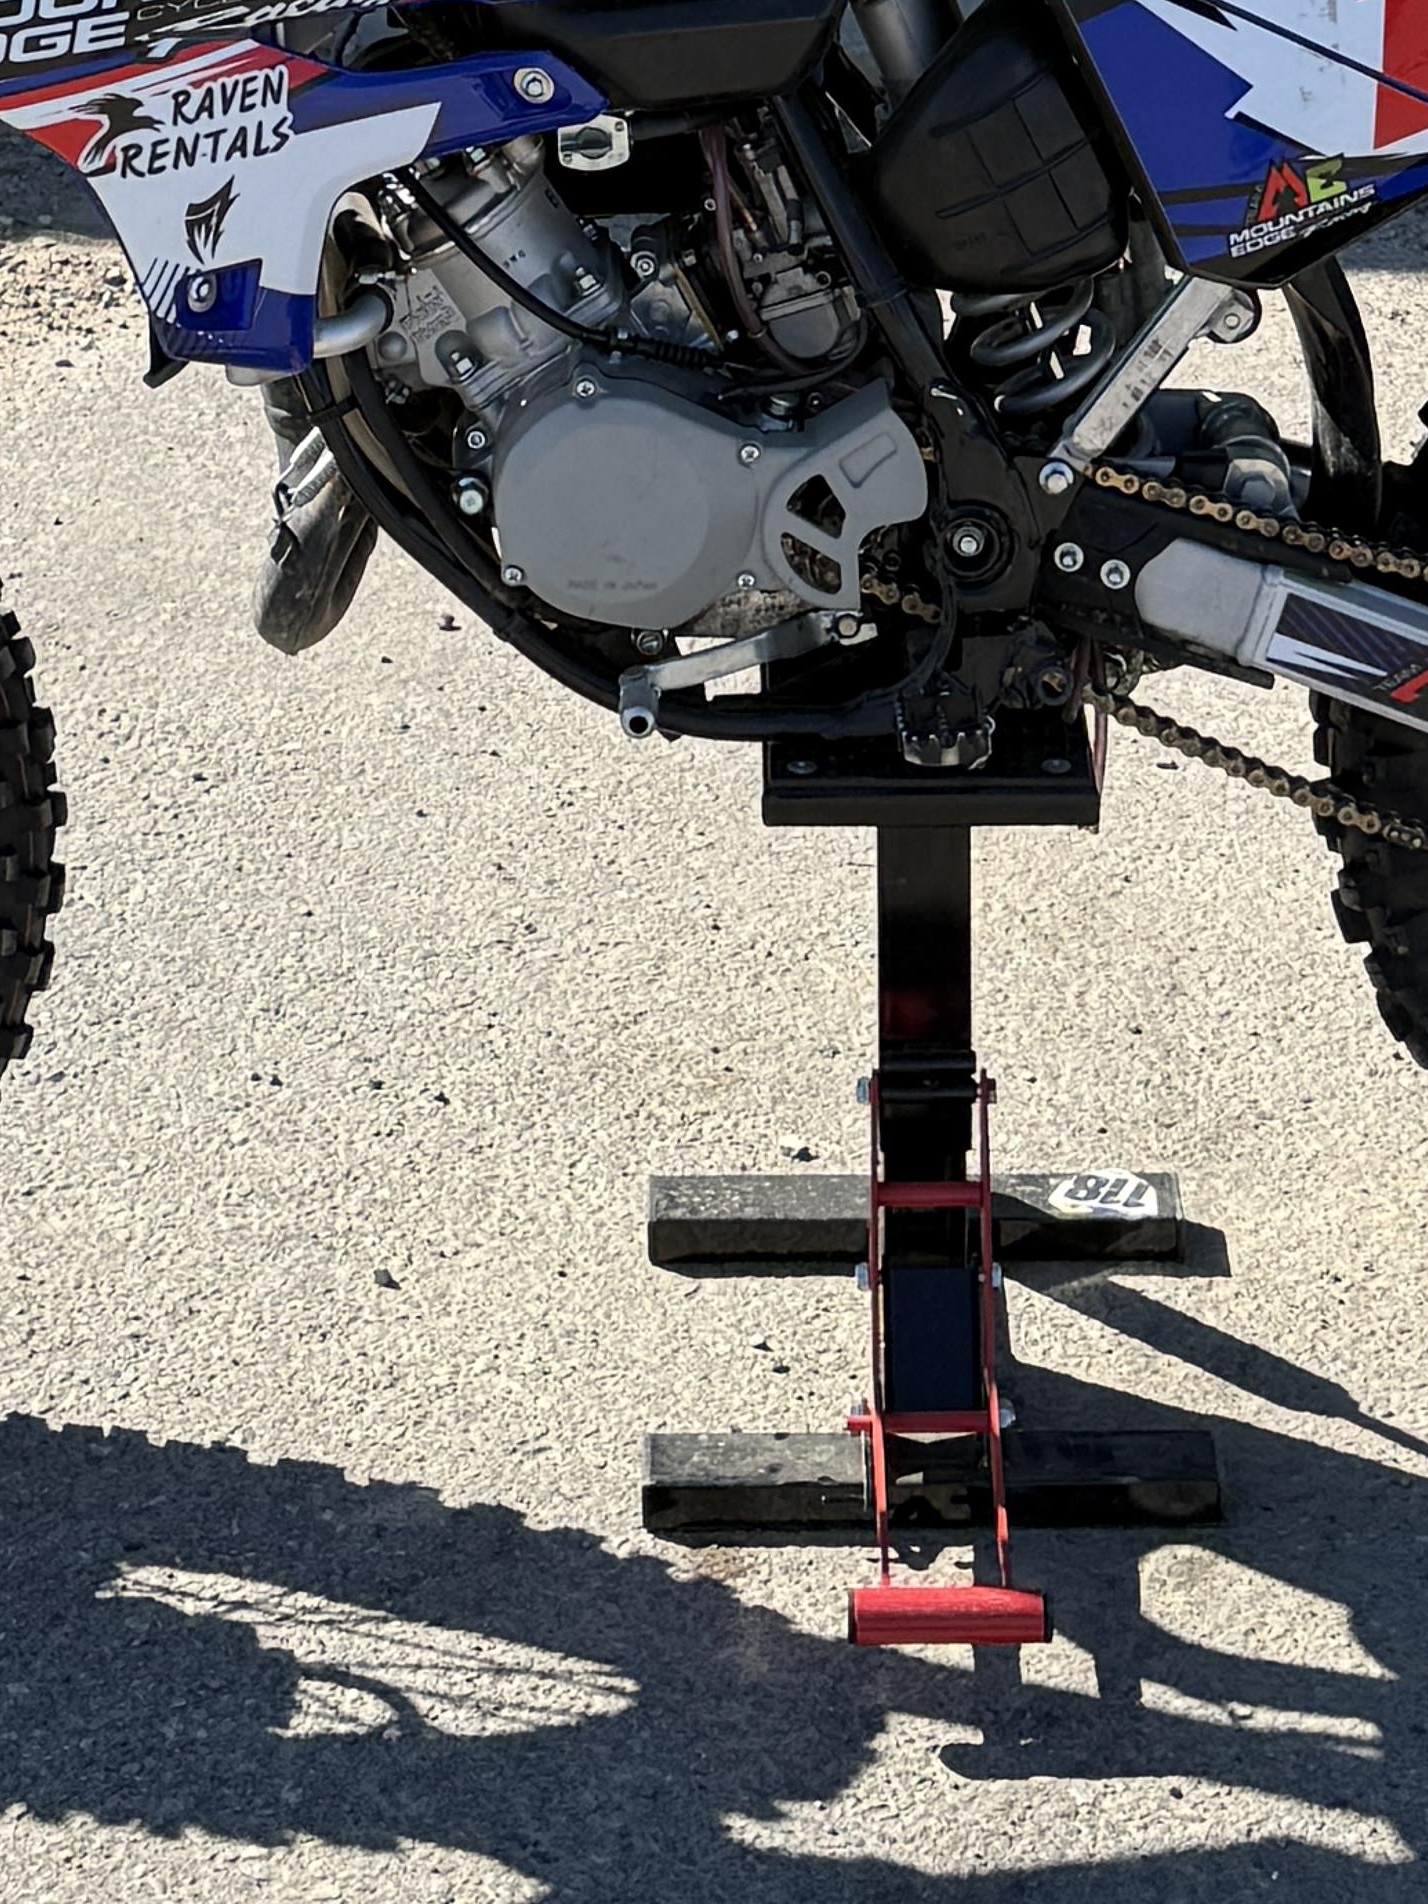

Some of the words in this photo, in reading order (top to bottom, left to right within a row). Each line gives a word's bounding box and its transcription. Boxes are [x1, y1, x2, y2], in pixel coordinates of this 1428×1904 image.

[170, 71, 286, 127] RAVEN
[119, 121, 295, 179] RENTALS
[1229, 183, 1376, 245] MOUNTAINS
[1230, 225, 1296, 258] EDGE
